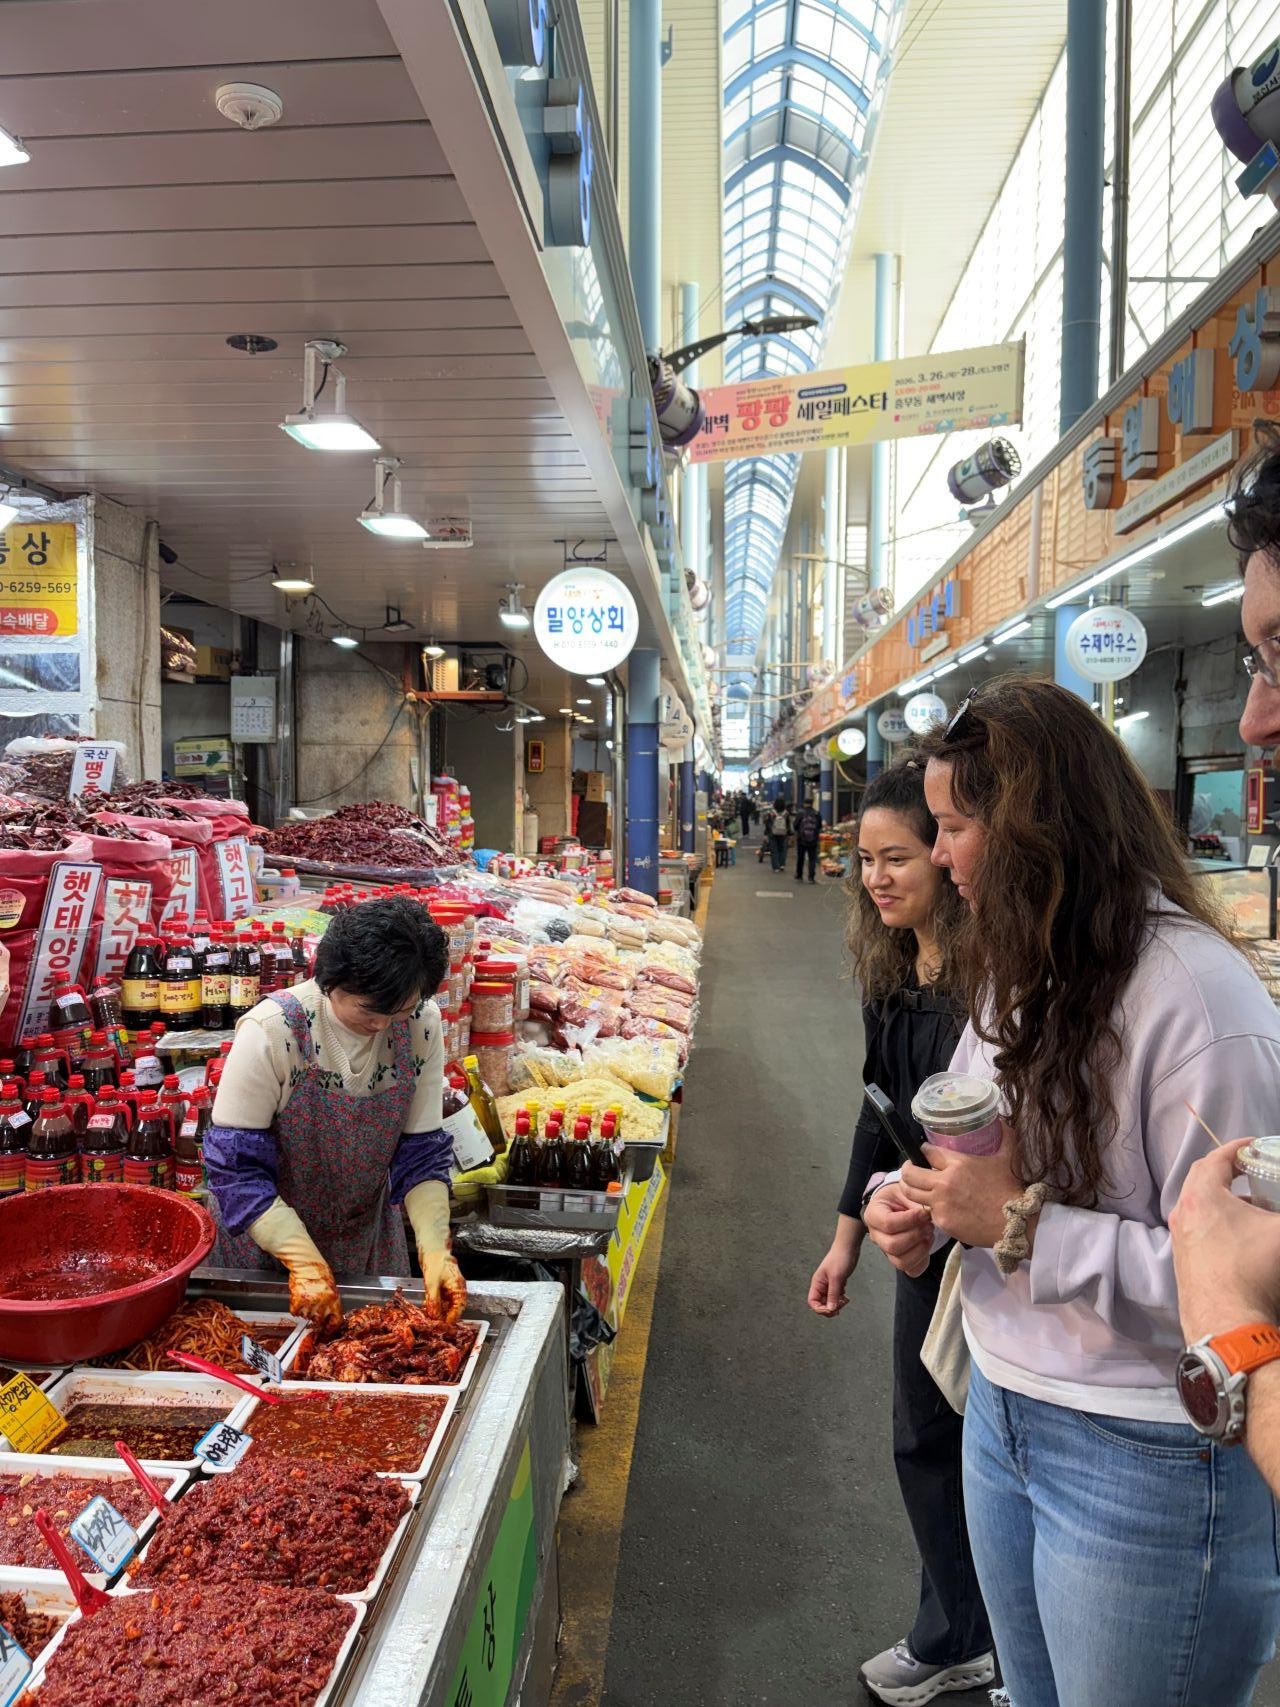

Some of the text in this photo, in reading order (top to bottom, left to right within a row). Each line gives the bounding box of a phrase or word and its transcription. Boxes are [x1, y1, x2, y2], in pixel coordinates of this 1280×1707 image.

[926, 390, 966, 404] 새벽시장
[736, 395, 791, 431] 팡팡
[797, 390, 888, 421] 세일페스타
[0, 612, 49, 631] 속배달
[547, 605, 624, 635] 밀양상회
[1080, 633, 1137, 653] 수제하우스
[83, 749, 109, 760] 국산
[82, 761, 104, 796] 땡초
